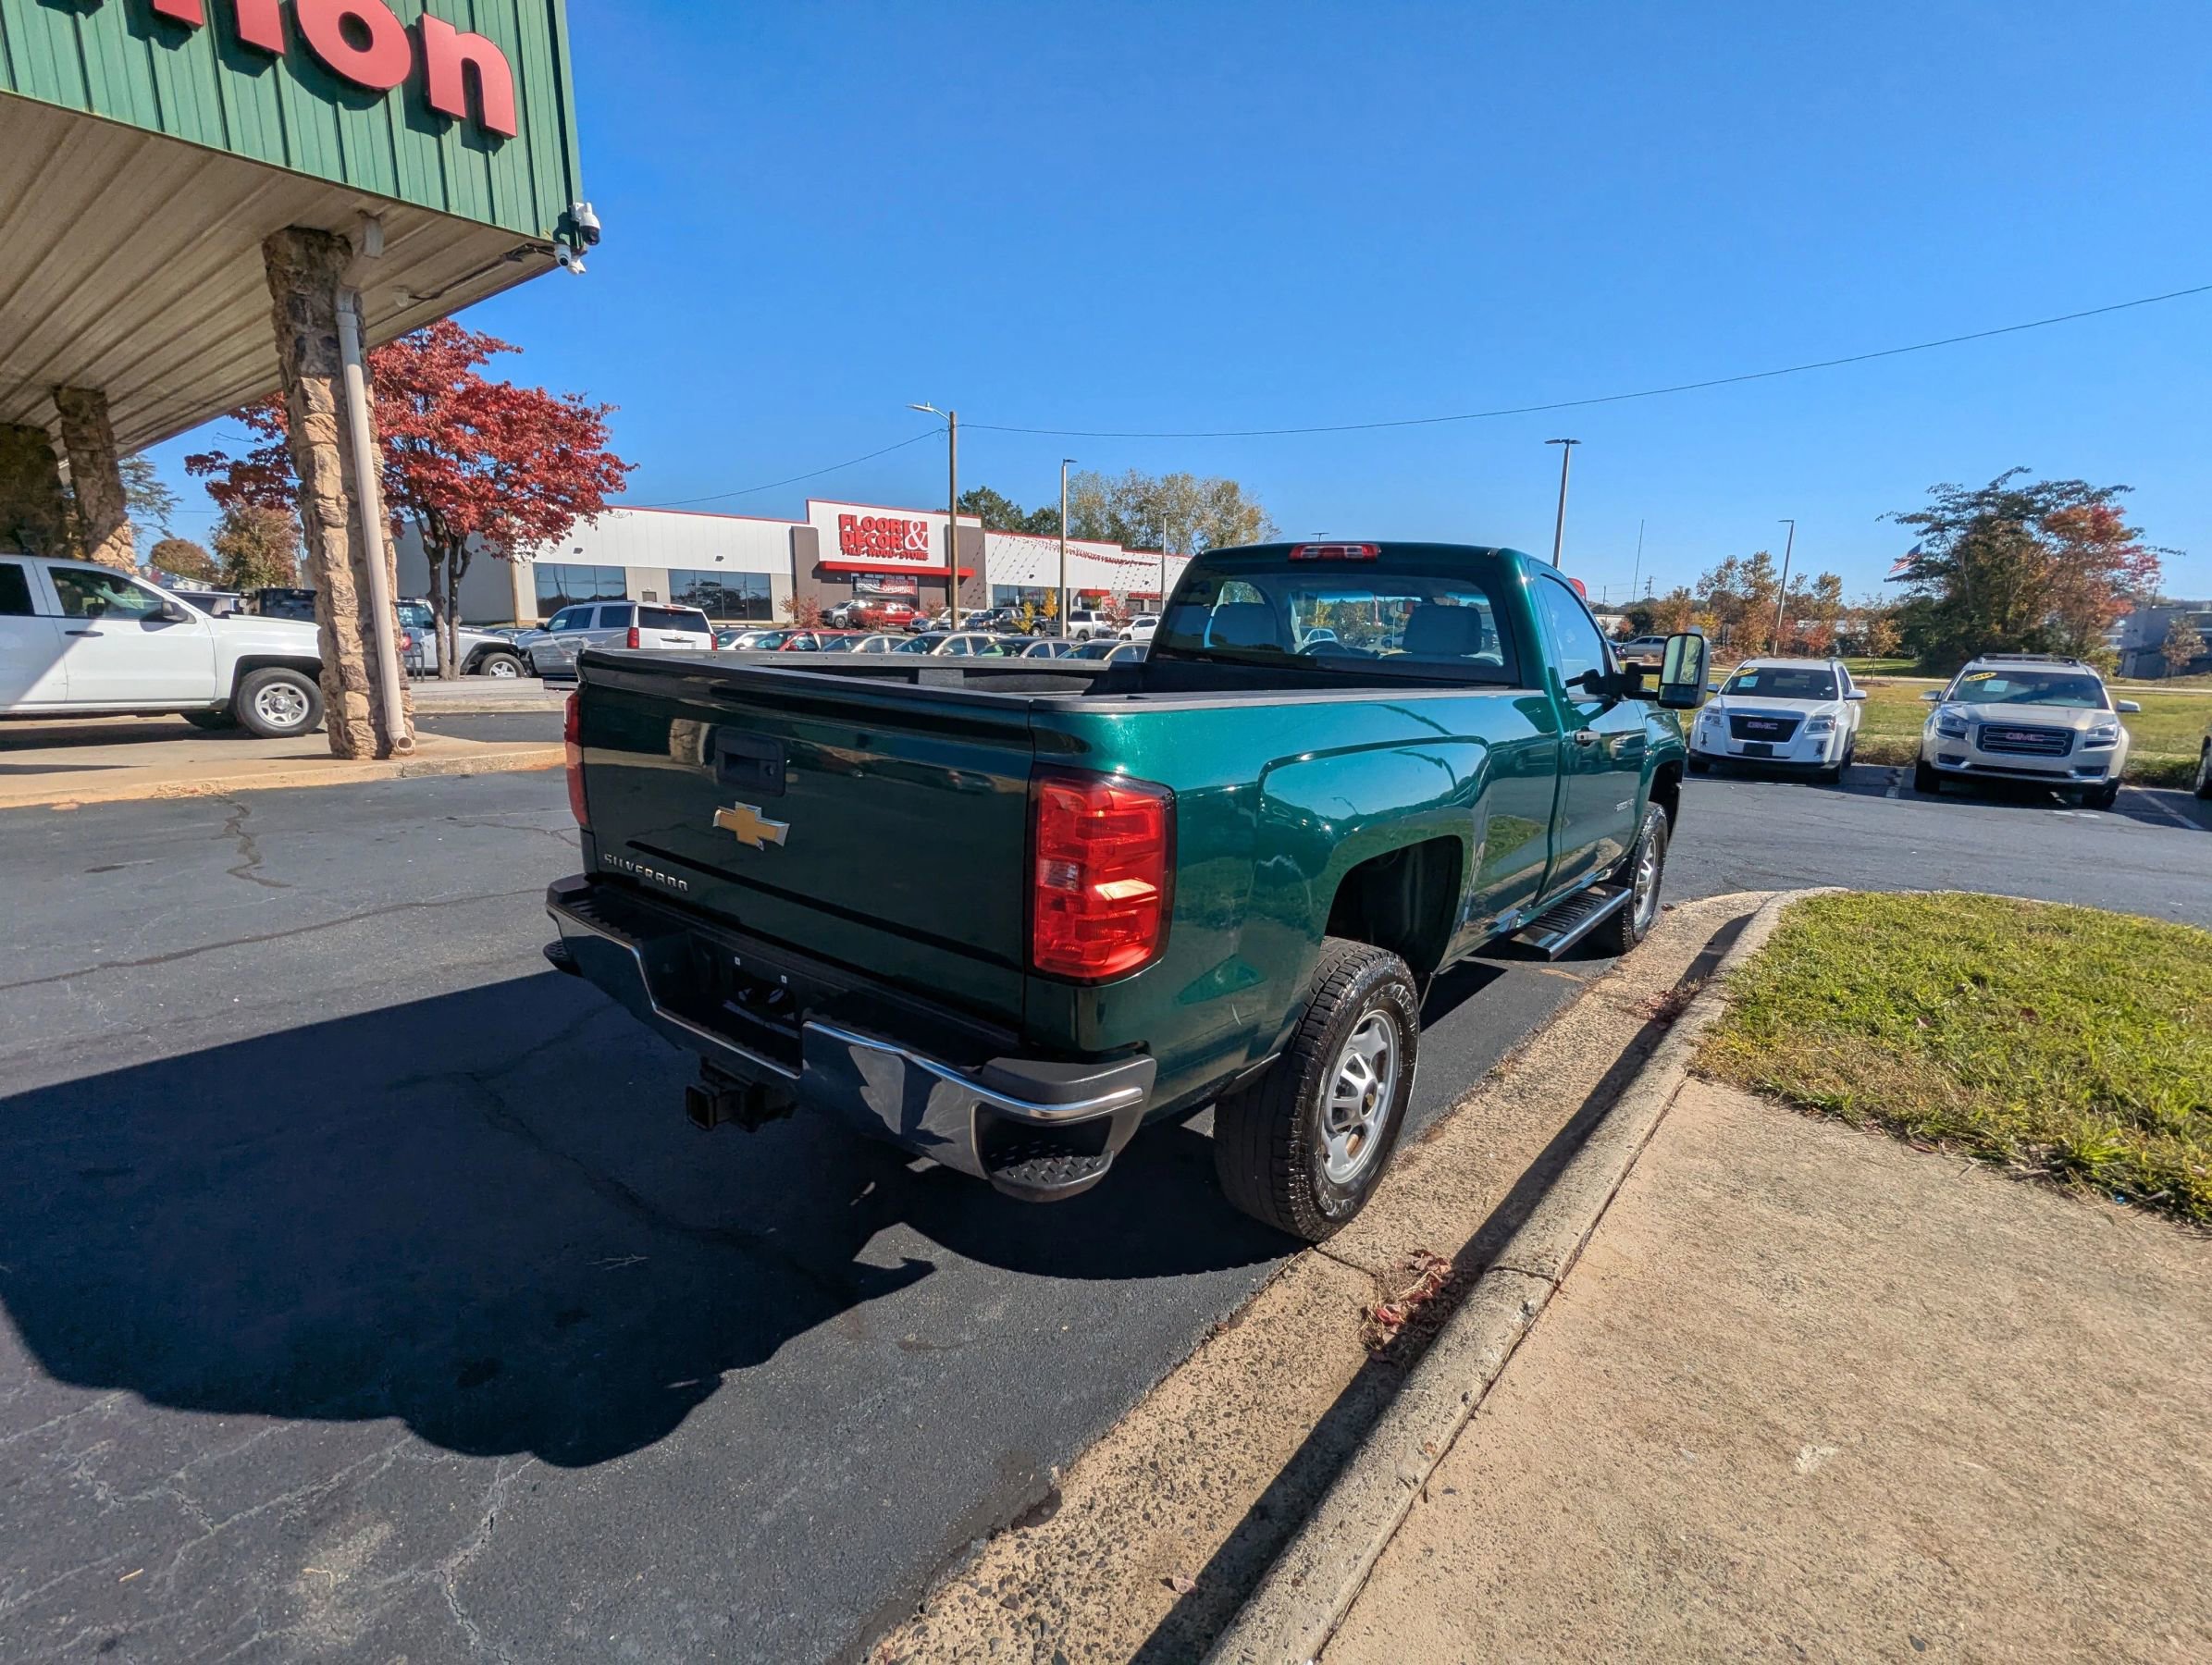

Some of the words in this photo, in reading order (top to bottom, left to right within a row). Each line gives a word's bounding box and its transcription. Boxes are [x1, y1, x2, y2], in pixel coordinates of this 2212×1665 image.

[838, 513, 902, 534] FLOOR
[903, 520, 929, 551] &
[839, 530, 903, 550] DECOR
[868, 549, 894, 558] WOOD
[899, 551, 929, 561] STONE
[1747, 722, 1778, 730] GMC
[2005, 732, 2045, 742] GMC
[603, 853, 689, 893] SILVERADO
